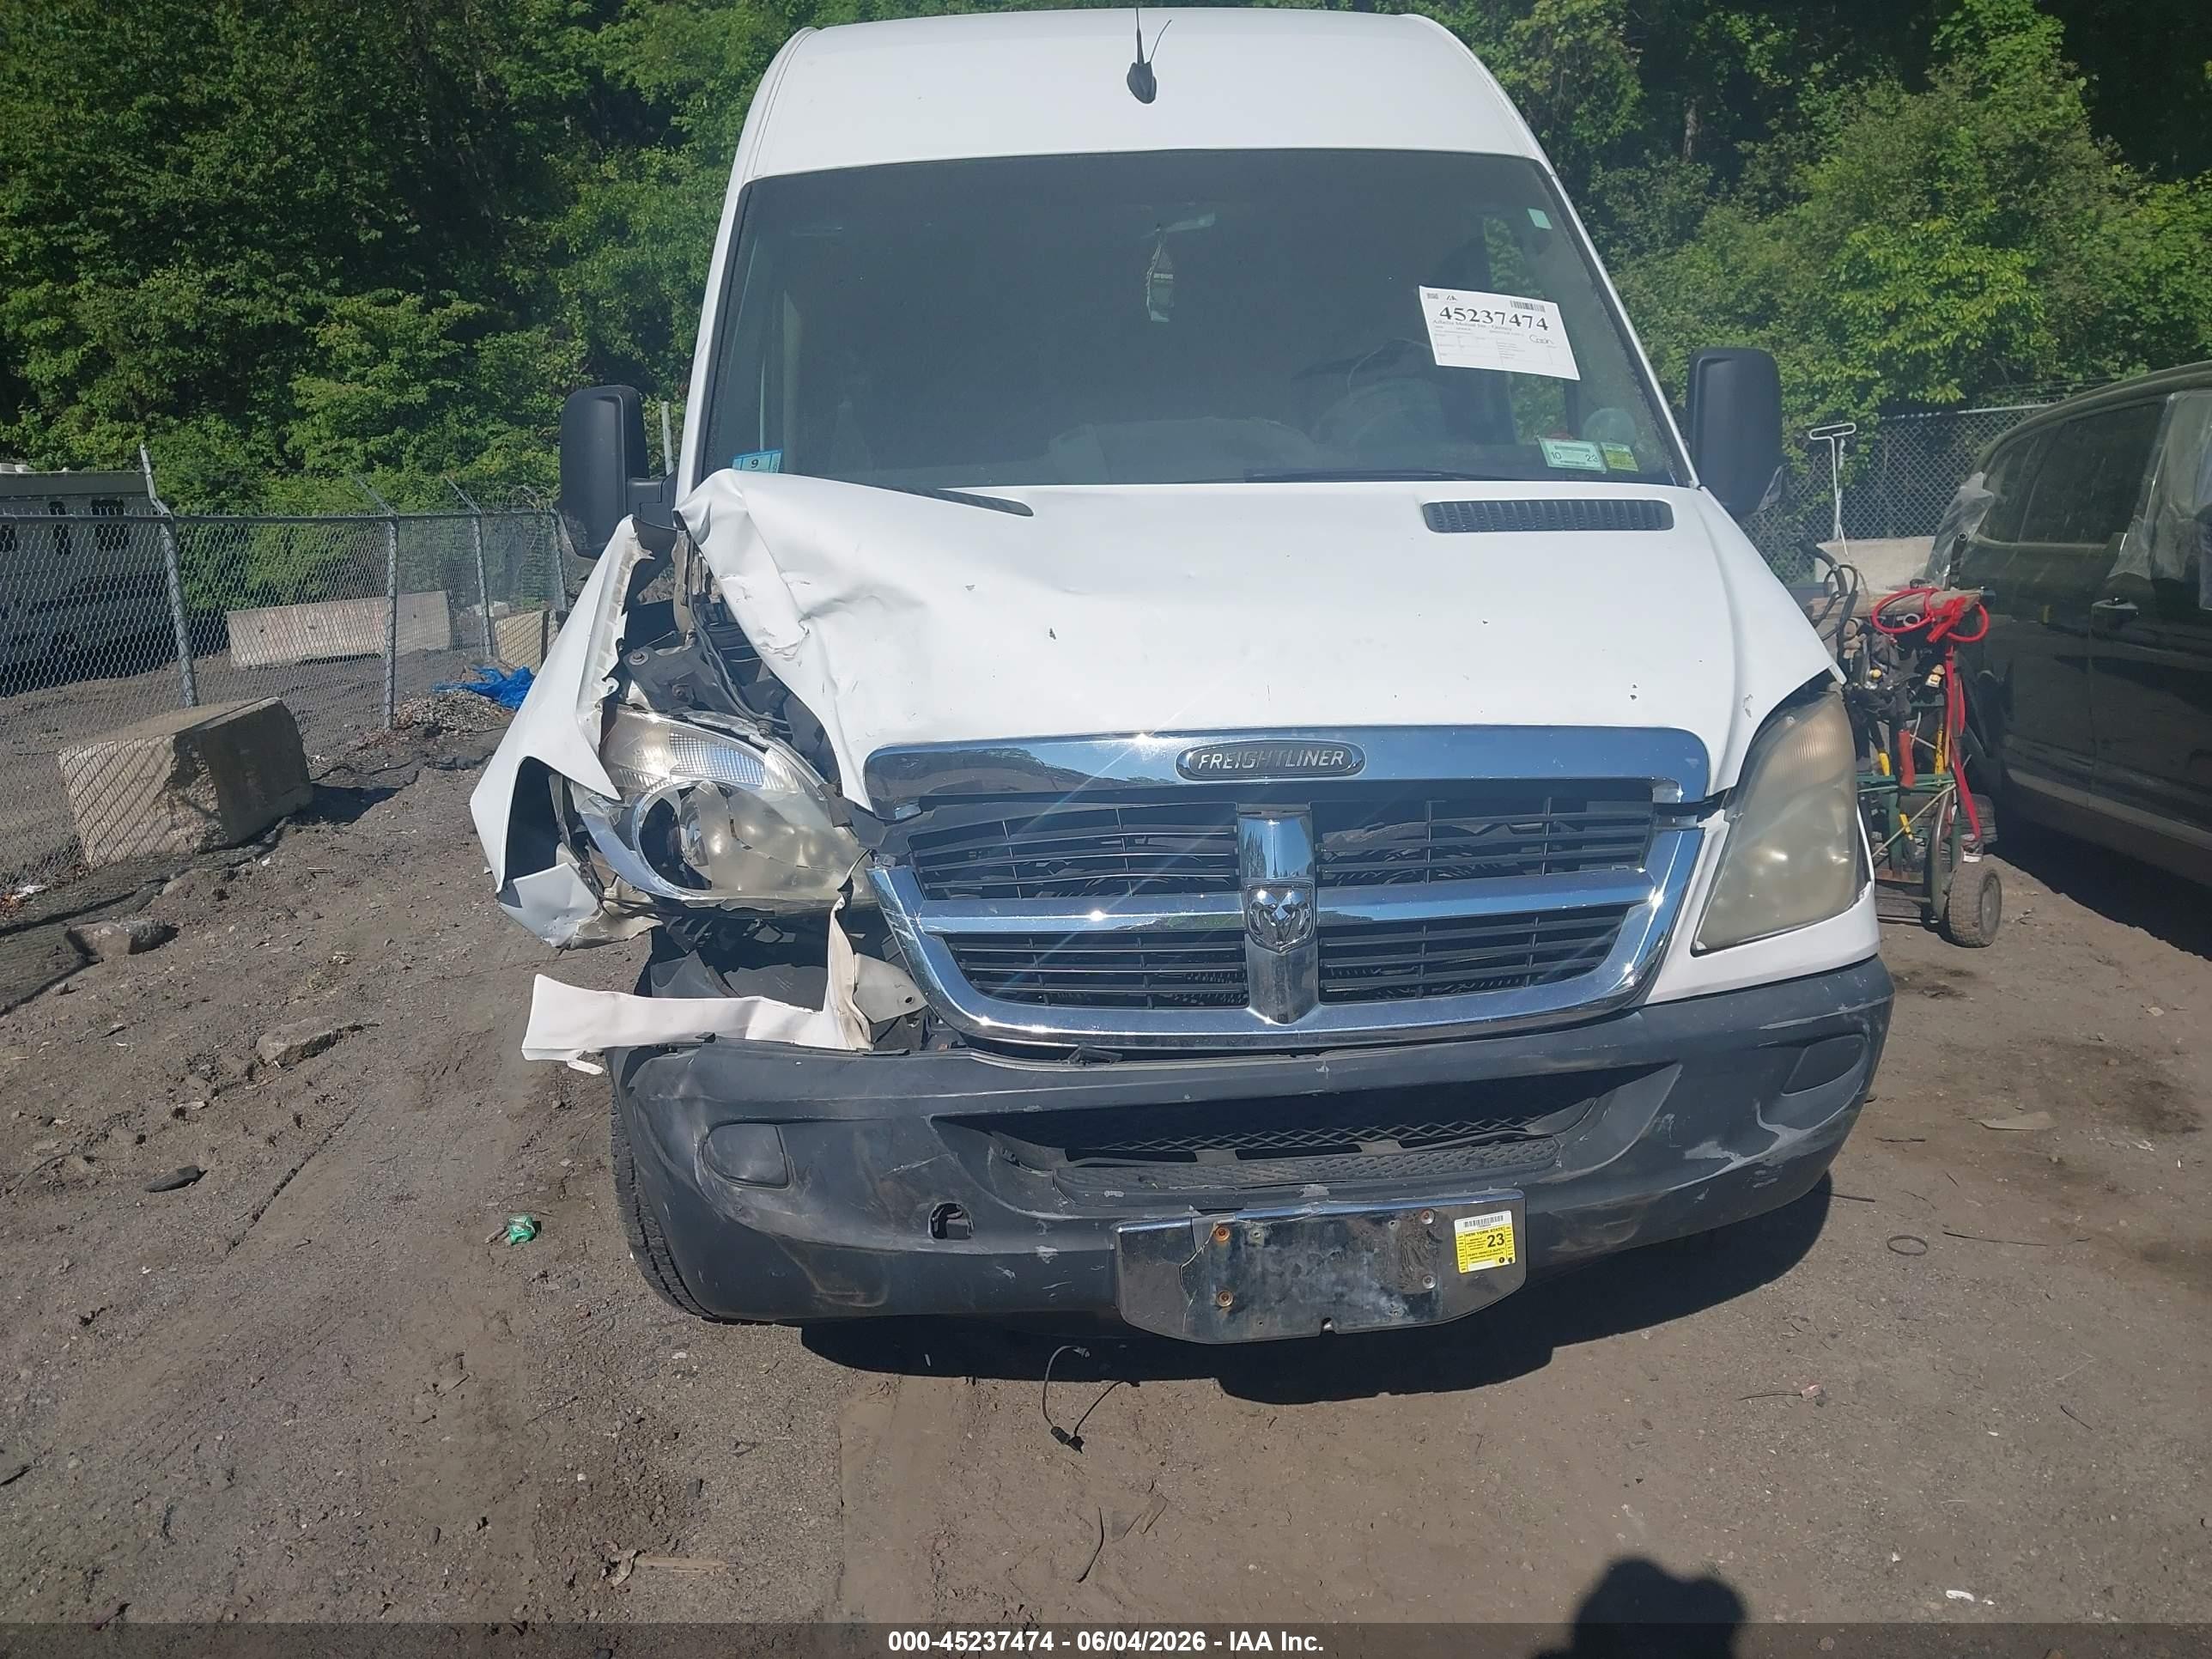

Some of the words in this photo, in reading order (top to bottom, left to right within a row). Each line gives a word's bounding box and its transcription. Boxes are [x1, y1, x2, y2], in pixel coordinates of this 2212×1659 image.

[1439, 306, 1548, 331] 45237474
[751, 459, 759, 468] 9
[1552, 452, 1562, 460] 10
[1198, 750, 1344, 769] FREIGHTLINER
[1487, 1233, 1504, 1248] 23
